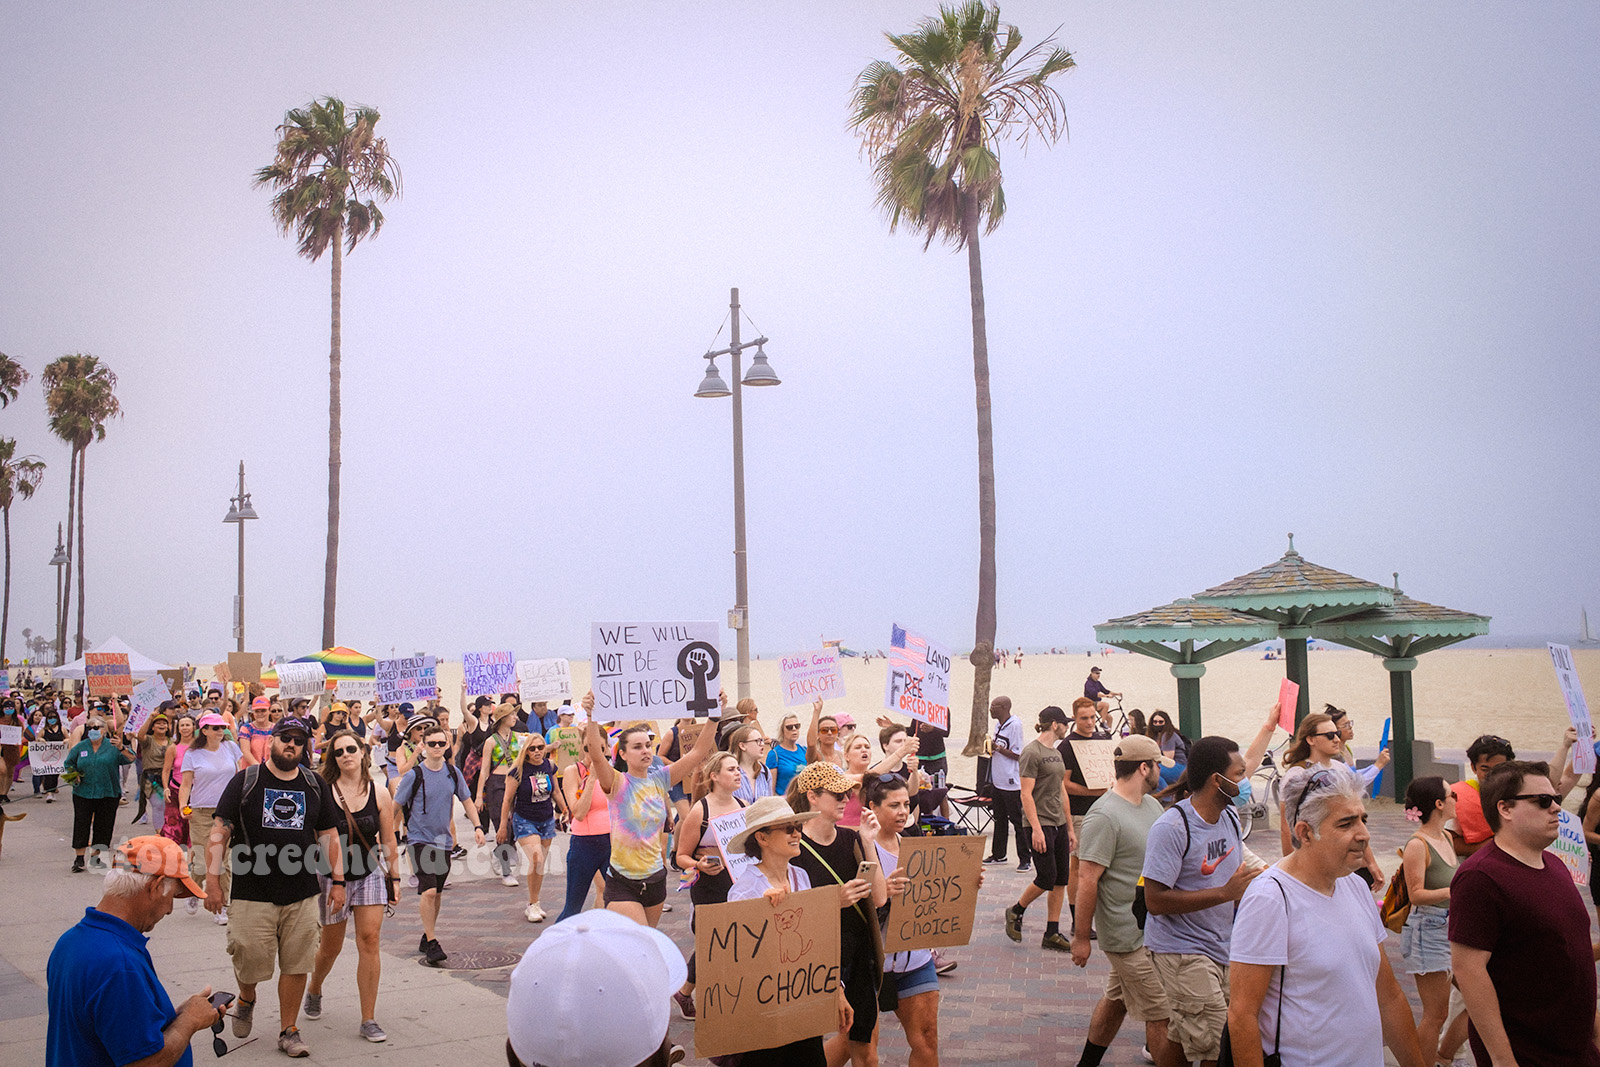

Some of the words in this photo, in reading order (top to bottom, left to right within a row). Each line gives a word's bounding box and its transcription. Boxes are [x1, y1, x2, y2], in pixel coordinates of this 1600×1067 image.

[600, 626, 641, 645] WE
[652, 626, 695, 642] WILL
[387, 659, 399, 671] YOU
[401, 657, 425, 669] REALLY
[597, 652, 624, 673] NOT
[634, 650, 658, 672] BE
[782, 658, 807, 671] Public
[926, 645, 951, 674] LAND
[377, 670, 398, 680] CARED
[400, 669, 418, 679] ABOUT
[419, 667, 435, 677] LIFE
[928, 672, 935, 684] of
[377, 681, 395, 691] THEN
[398, 678, 416, 689] GUNS
[417, 677, 436, 687] WOULD
[497, 682, 517, 693] GUN
[789, 678, 819, 699] FUCK
[818, 673, 837, 692] OFF
[599, 679, 687, 709] SILENCED
[927, 700, 948, 729] BIRTH
[558, 730, 576, 739] Guns
[29, 743, 65, 752] abortion
[1098, 744, 1113, 755] WI
[32, 765, 65, 775] Healthca
[714, 818, 742, 833] When
[1208, 838, 1227, 861] NIKE
[906, 847, 947, 879] OUR
[902, 875, 962, 907] PUSSYS
[914, 901, 938, 918] OUR
[708, 919, 769, 963] MY
[703, 976, 744, 1019] MY
[757, 963, 839, 1004] CHOICE
